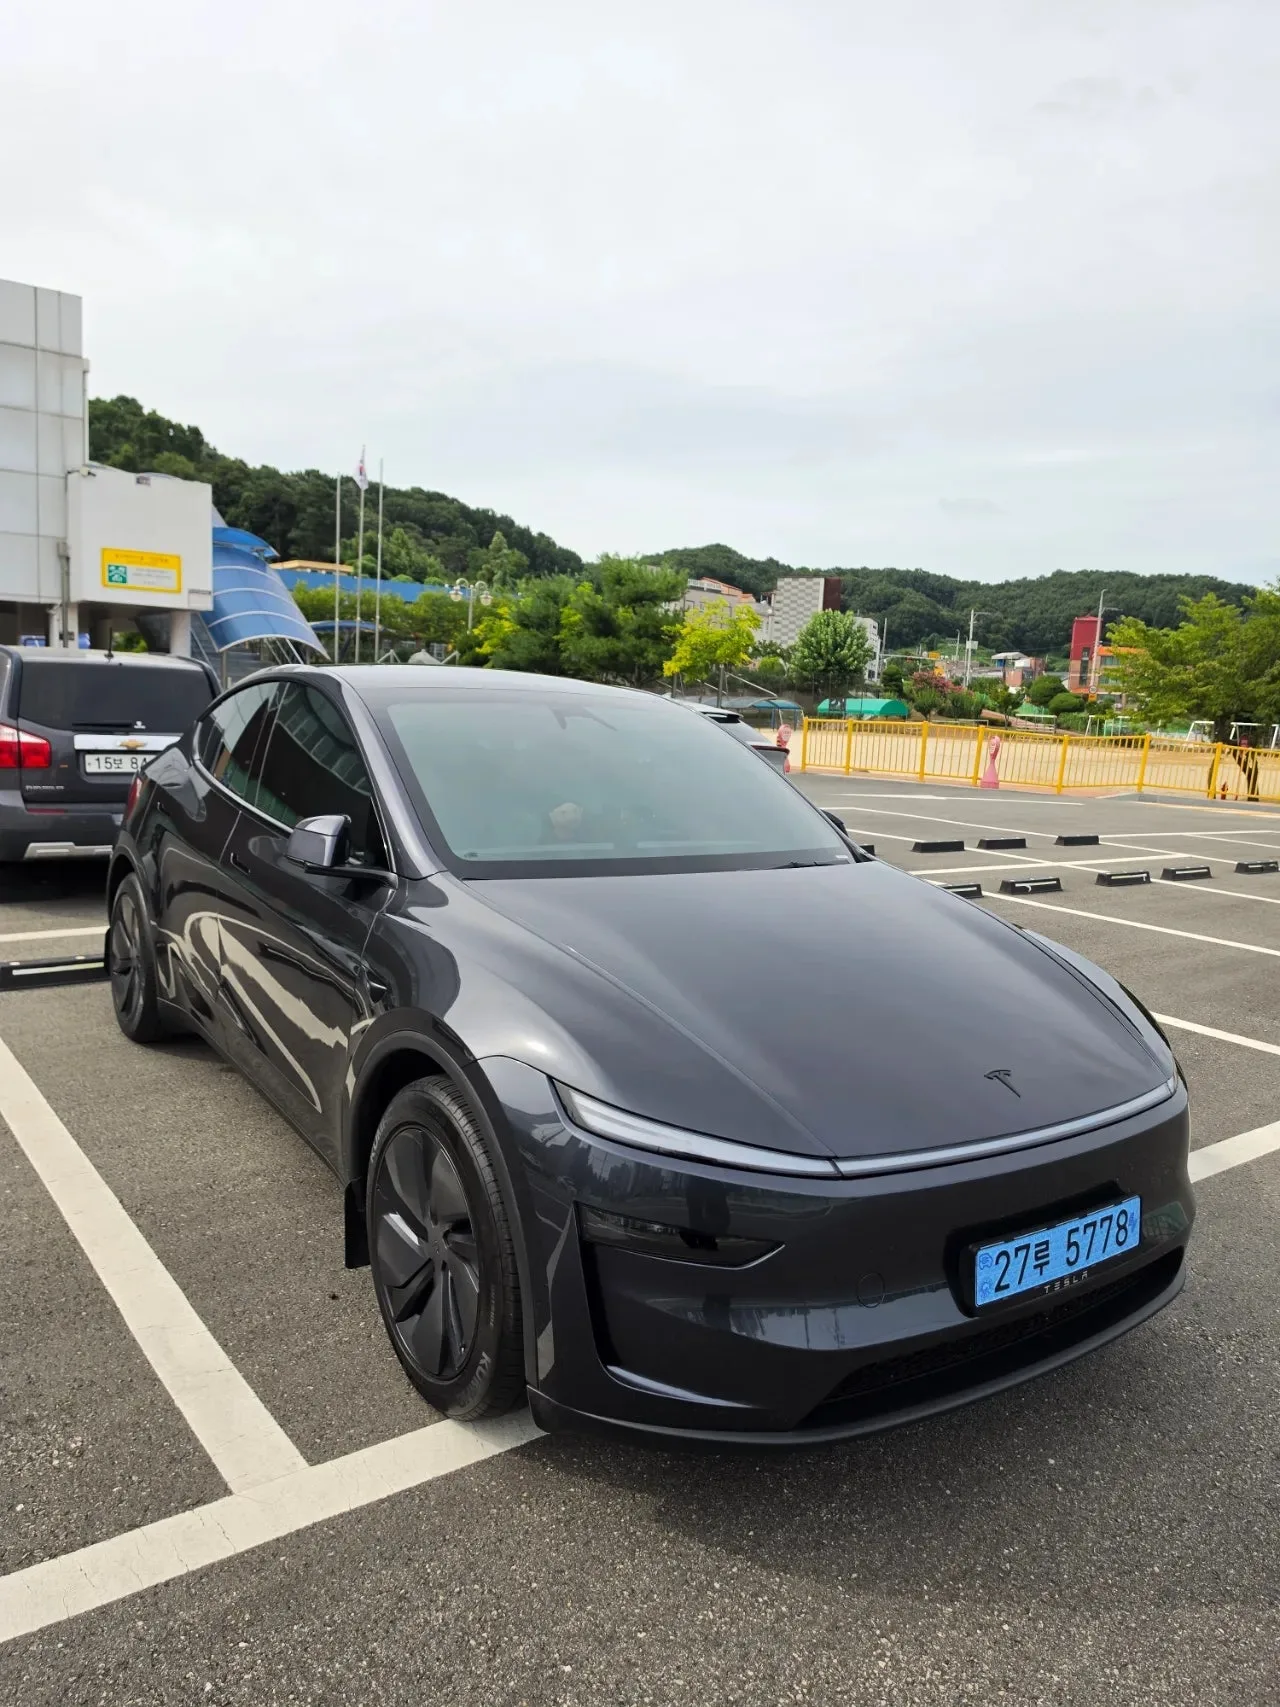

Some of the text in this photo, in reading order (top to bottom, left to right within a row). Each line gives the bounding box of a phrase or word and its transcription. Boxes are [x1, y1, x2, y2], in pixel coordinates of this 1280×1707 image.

[994, 1209, 1128, 1293] 27루 5778
[1044, 1271, 1088, 1294] TESLA
